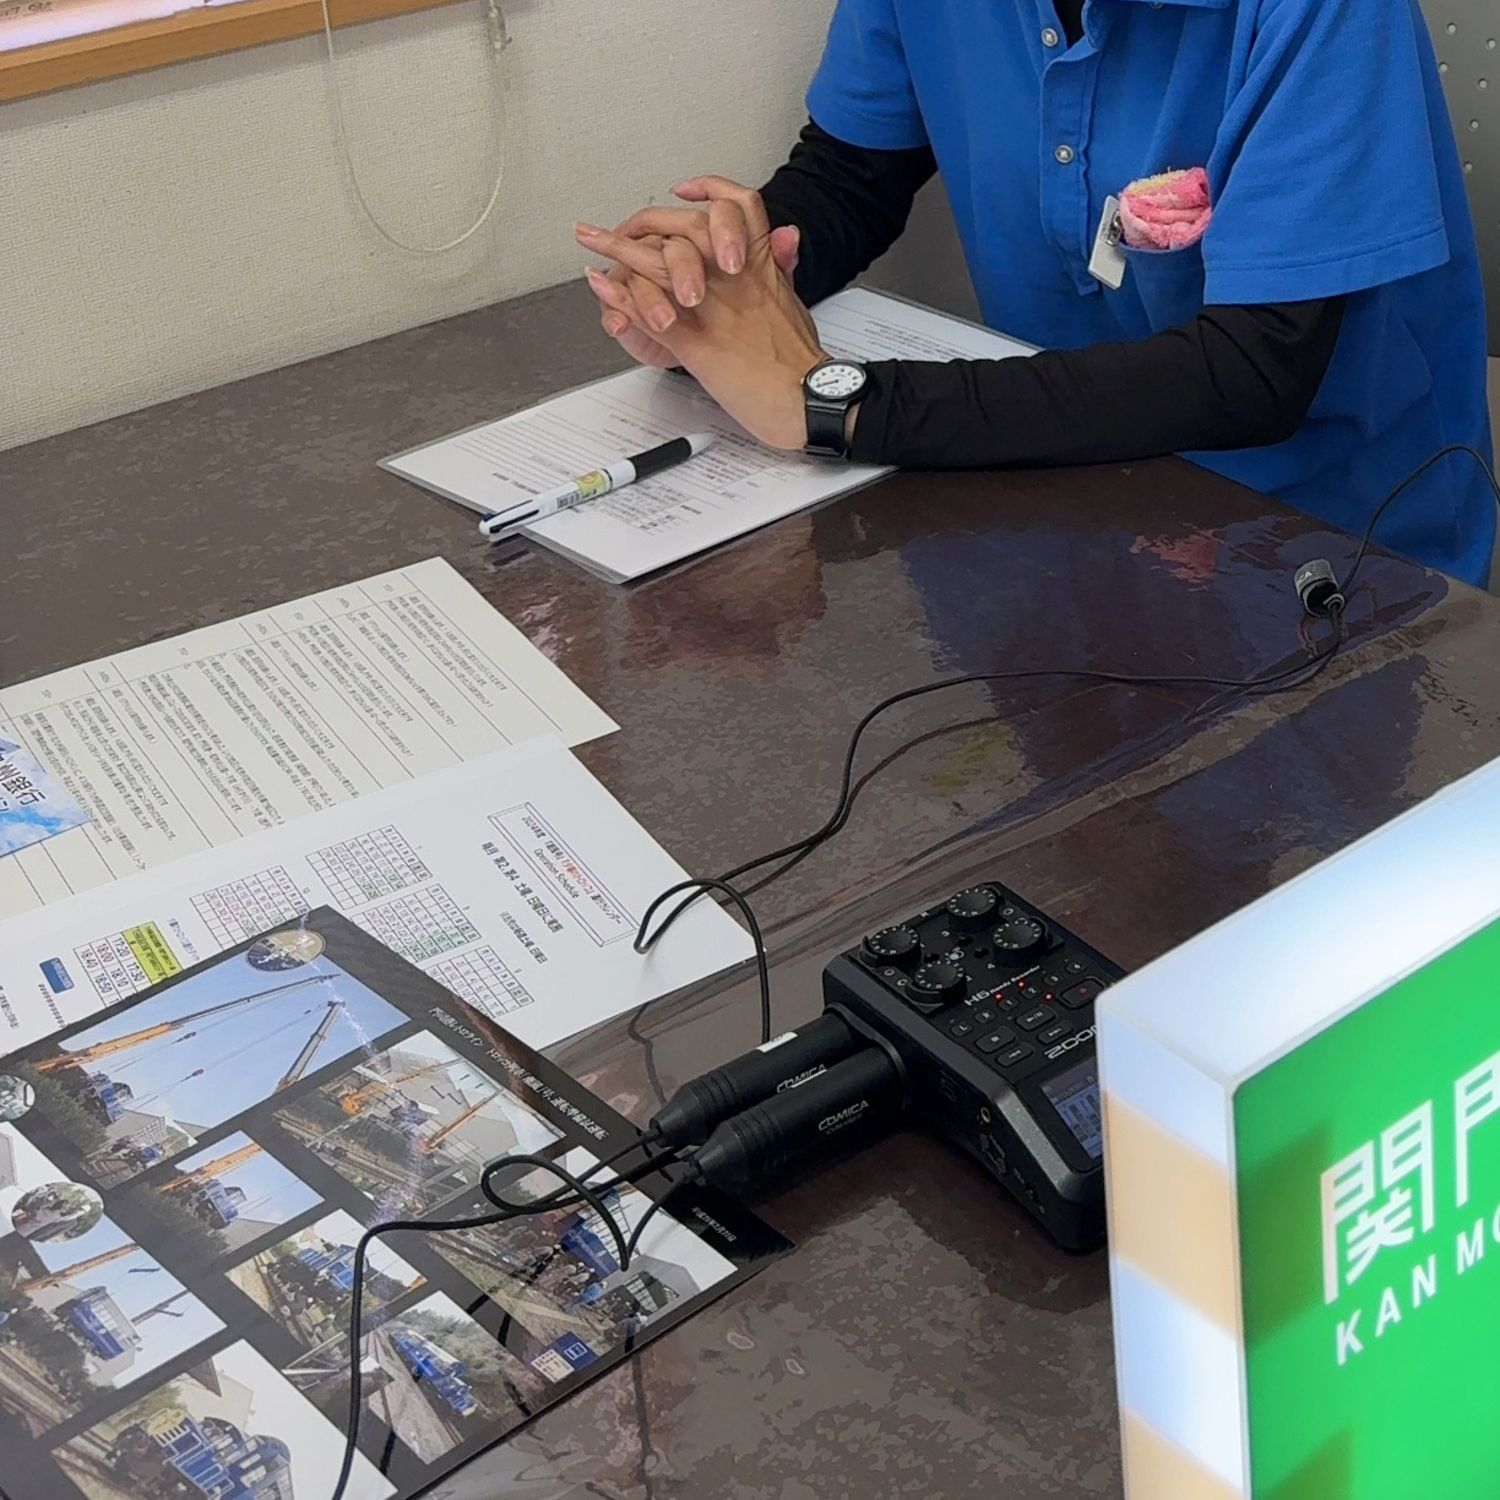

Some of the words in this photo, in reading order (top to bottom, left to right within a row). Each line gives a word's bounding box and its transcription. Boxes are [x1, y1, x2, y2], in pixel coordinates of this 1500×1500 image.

[482, 842, 499, 855] 毎月
[533, 848, 558, 877] Operation
[556, 872, 580, 899] Schedule
[80, 948, 98, 970] 18:40
[95, 972, 112, 994] 18:50
[97, 943, 115, 963] 18:00
[110, 968, 129, 988] 18:10
[111, 937, 129, 958] 17:20
[126, 961, 145, 982] 17:30
[964, 989, 990, 1006] H6
[777, 1063, 827, 1094] COMICA
[818, 1099, 869, 1131] COMICA
[1335, 1253, 1438, 1365] KAN
